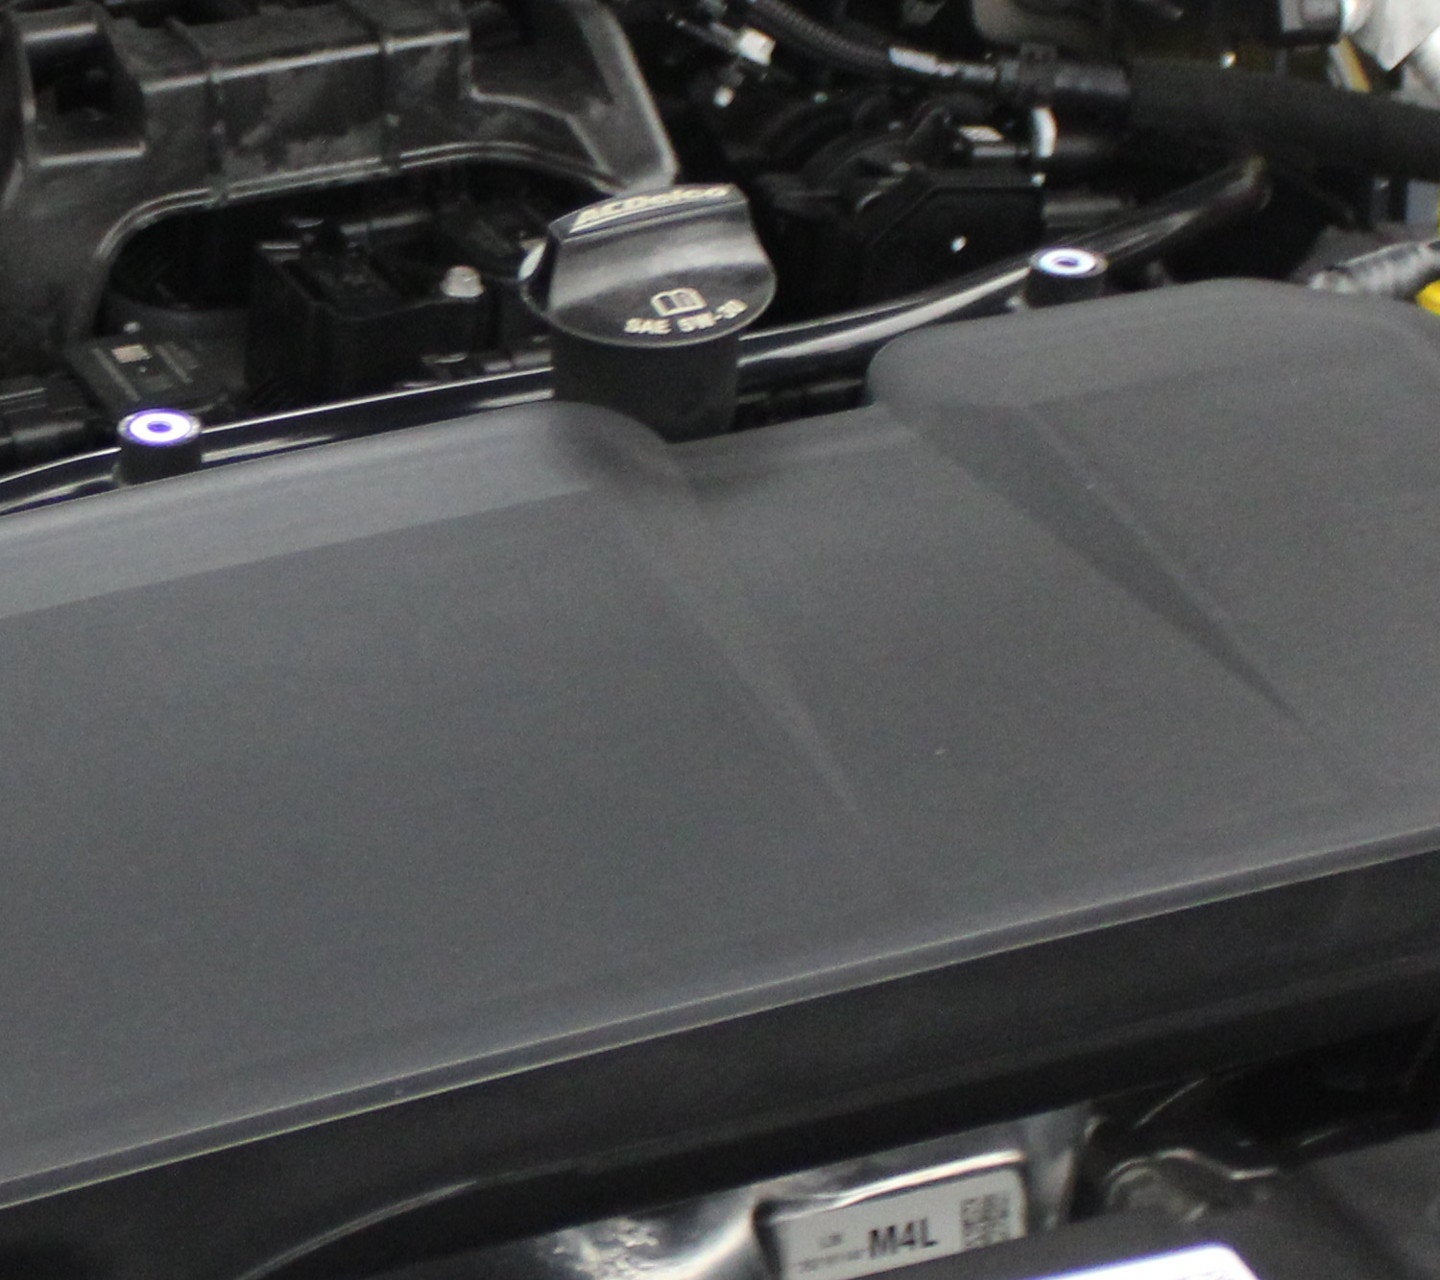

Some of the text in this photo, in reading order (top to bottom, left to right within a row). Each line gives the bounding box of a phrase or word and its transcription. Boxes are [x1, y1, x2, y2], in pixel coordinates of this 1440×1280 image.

[573, 186, 729, 227] ACDelco
[624, 317, 672, 334] SAE
[868, 1218, 939, 1258] M4L
